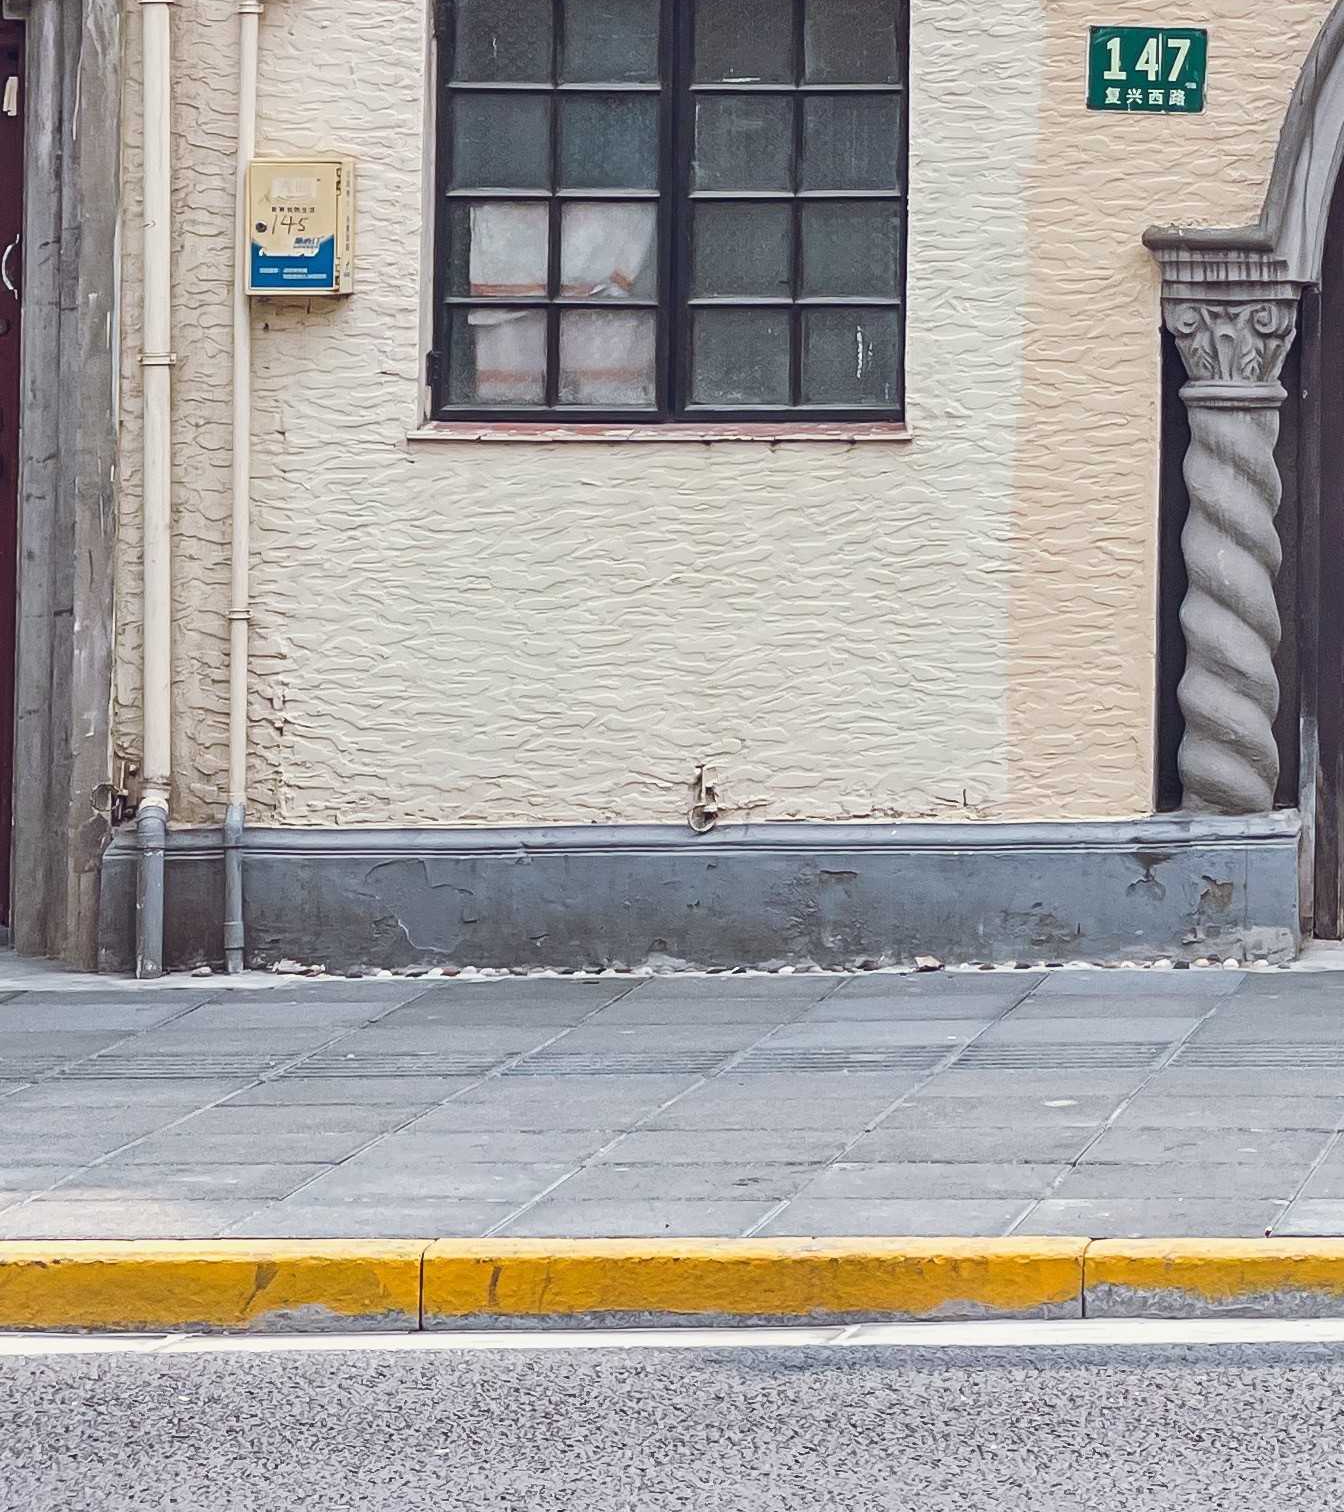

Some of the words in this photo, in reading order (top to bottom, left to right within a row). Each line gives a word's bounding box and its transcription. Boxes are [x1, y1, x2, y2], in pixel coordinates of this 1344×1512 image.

[1103, 37, 1192, 82] 147
[1104, 86, 1186, 106] 复兴西路
[271, 214, 309, 236] 145
